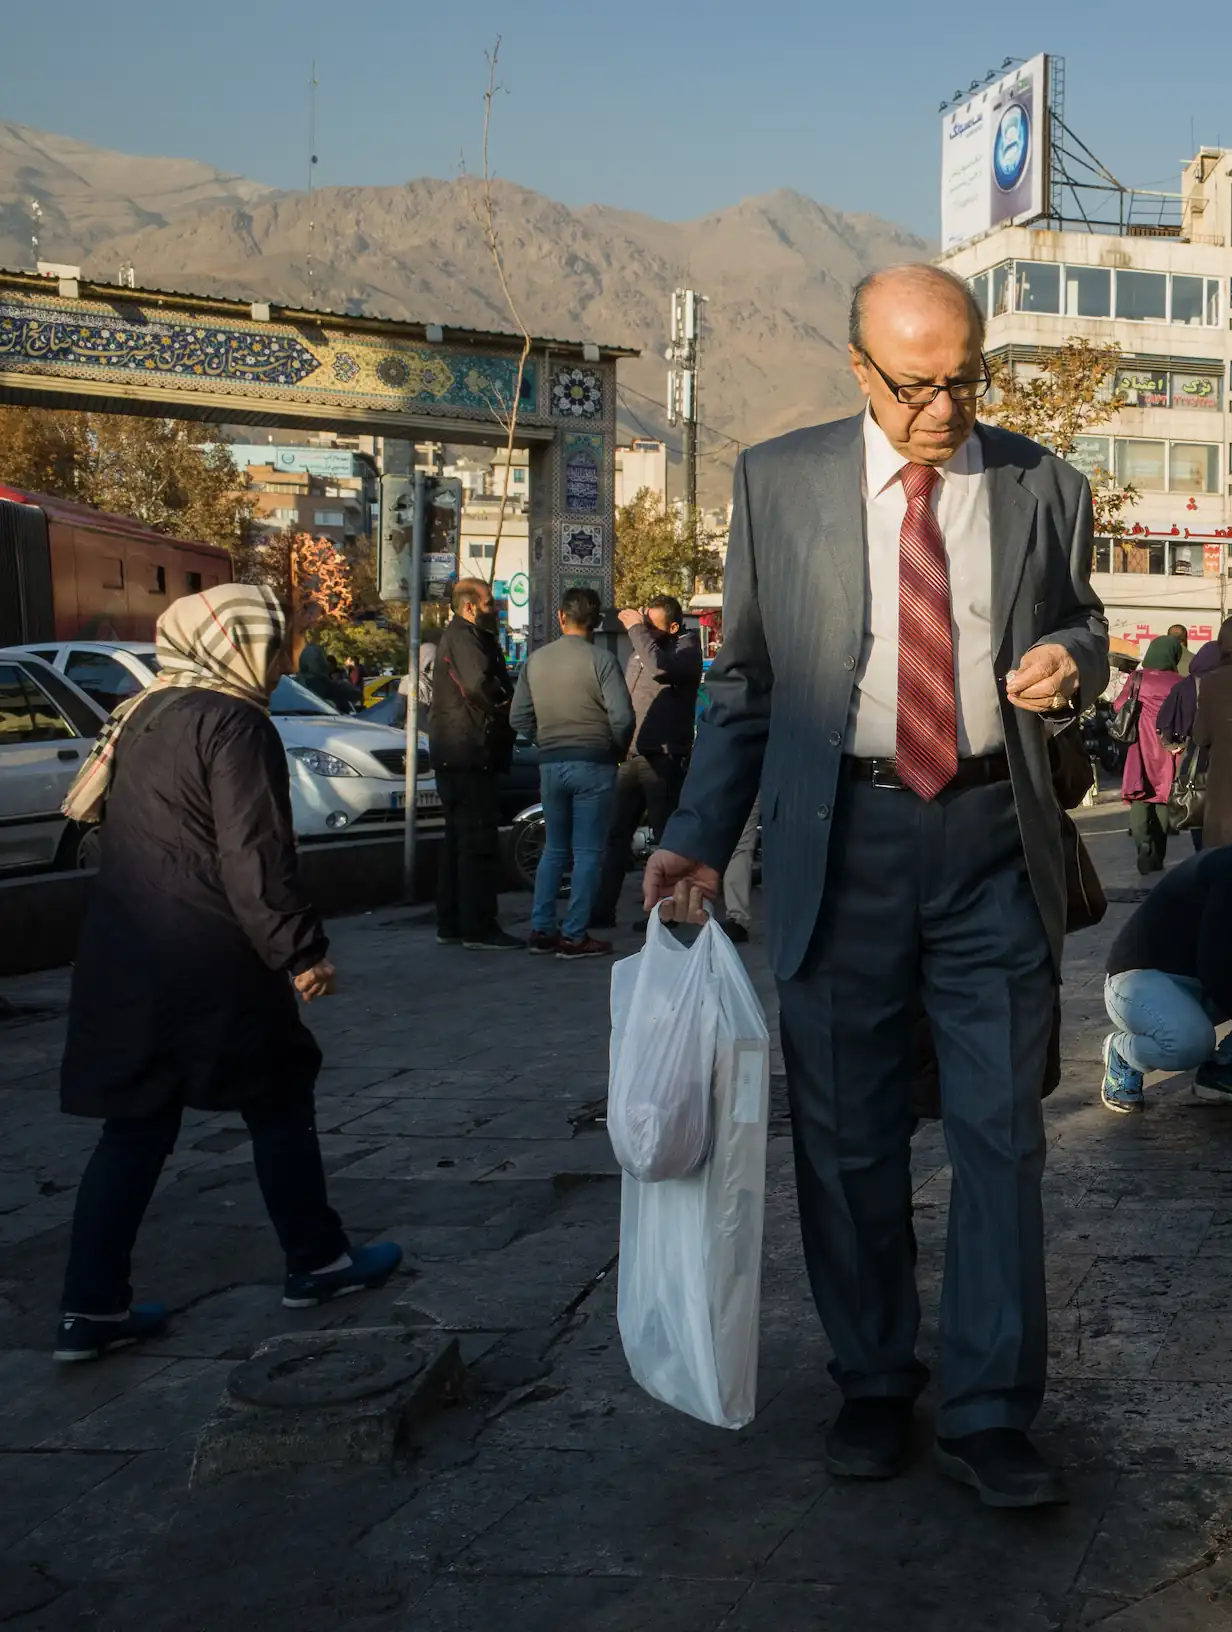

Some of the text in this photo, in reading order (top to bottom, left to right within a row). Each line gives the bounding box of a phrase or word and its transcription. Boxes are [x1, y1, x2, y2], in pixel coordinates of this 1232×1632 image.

[1120, 375, 1164, 391] اعتیاد
[1182, 378, 1212, 396] ترک
[1124, 522, 1180, 538] فرش
